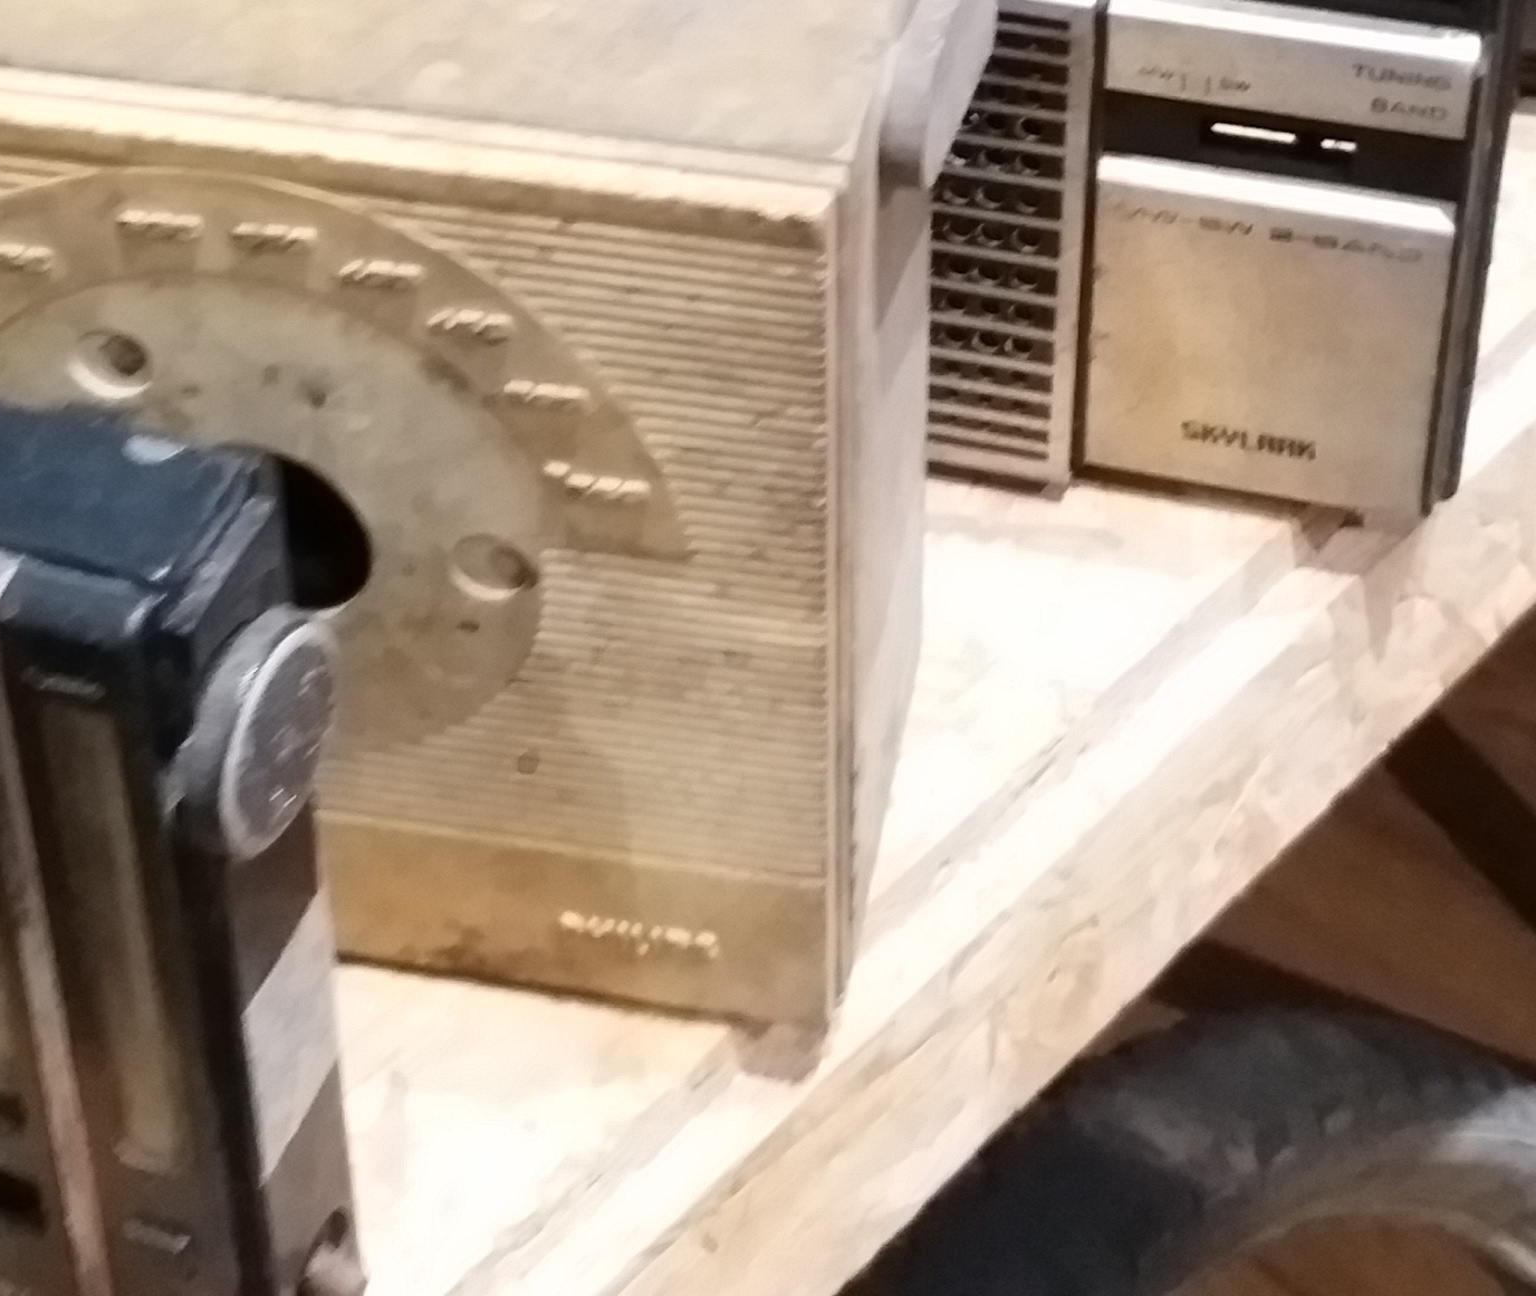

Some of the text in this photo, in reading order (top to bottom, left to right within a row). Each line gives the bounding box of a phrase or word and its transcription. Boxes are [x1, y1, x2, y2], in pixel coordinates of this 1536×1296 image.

[1353, 62, 1452, 93] TUNING
[1370, 95, 1449, 123] BAND
[1180, 419, 1317, 462] SKYLARK
